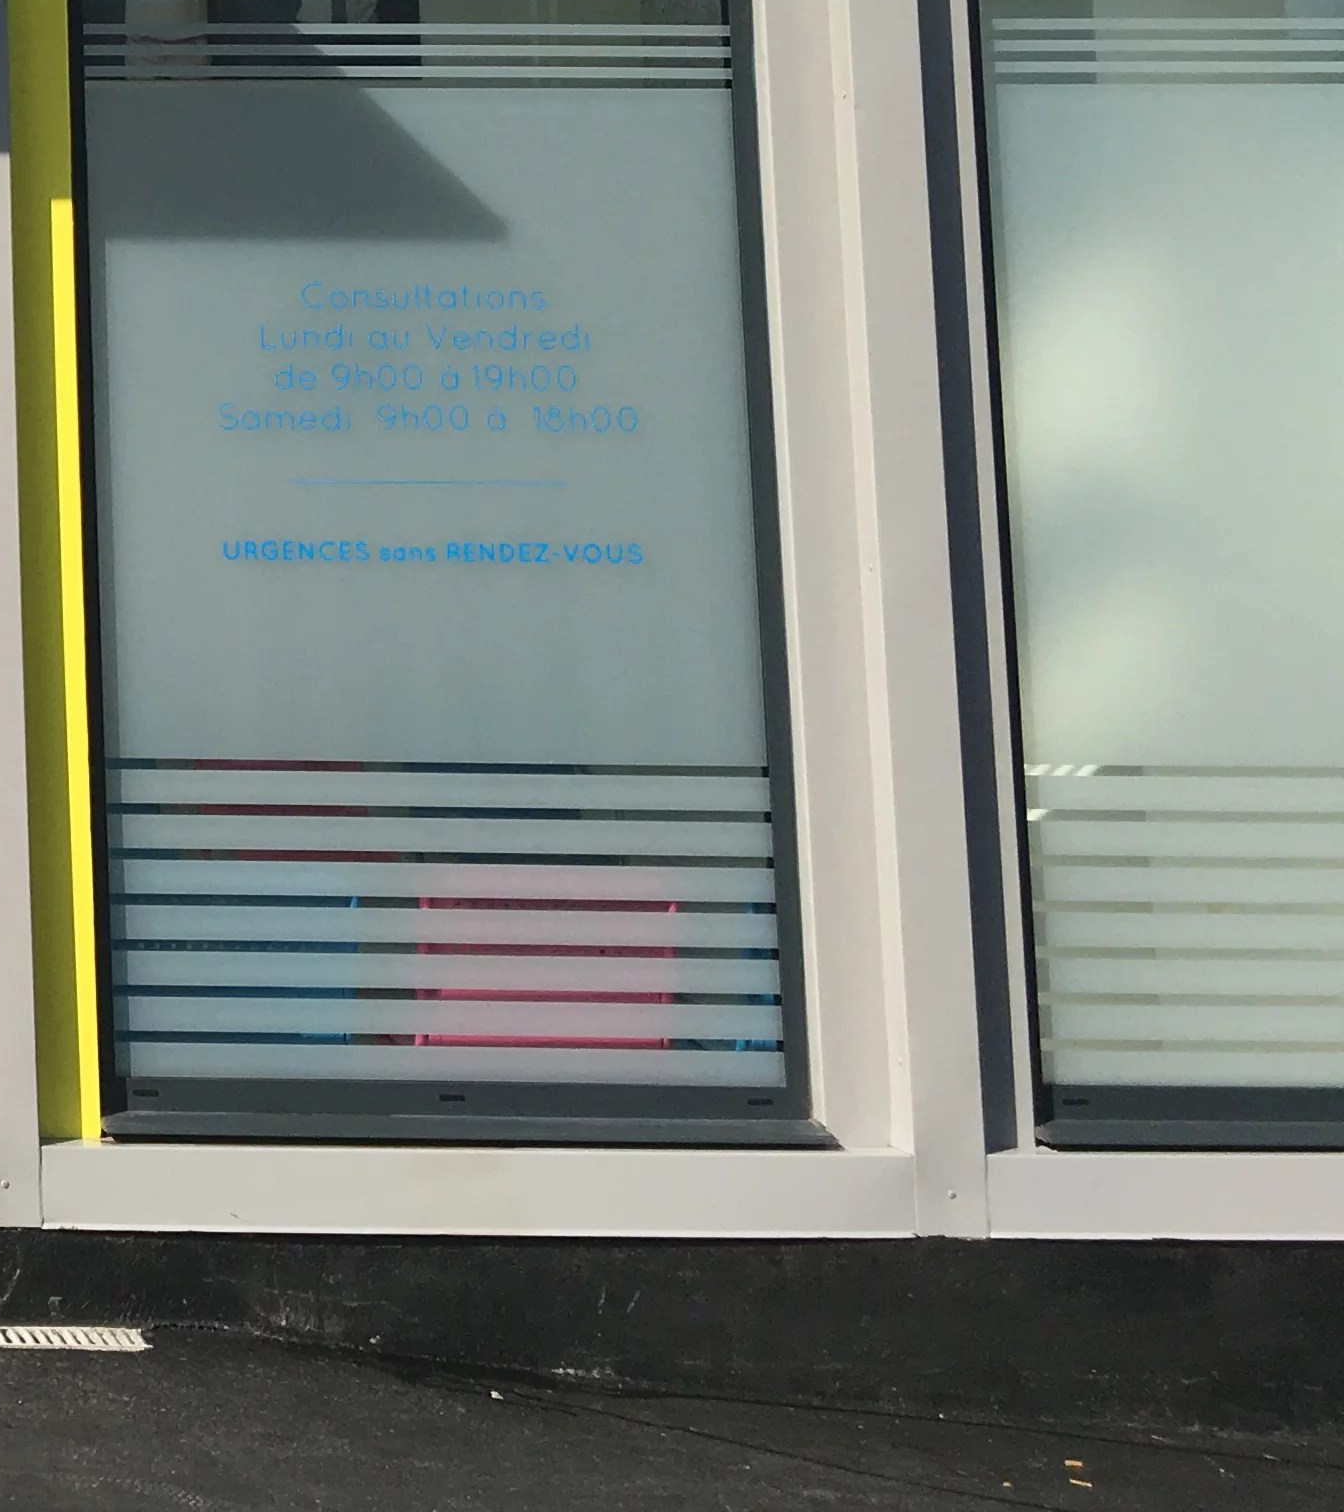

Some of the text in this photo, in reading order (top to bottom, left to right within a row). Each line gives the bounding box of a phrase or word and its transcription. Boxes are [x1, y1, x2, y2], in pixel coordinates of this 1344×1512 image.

[298, 280, 549, 312] Consultations
[258, 322, 592, 353] Lundi au Vendredi
[273, 362, 578, 393] de 9h00 à 19h00
[218, 403, 352, 433] Samedi
[376, 403, 470, 433] 9h00
[486, 405, 507, 434] à
[221, 539, 645, 566] URGENCES sans RENDEZ-VOUS
